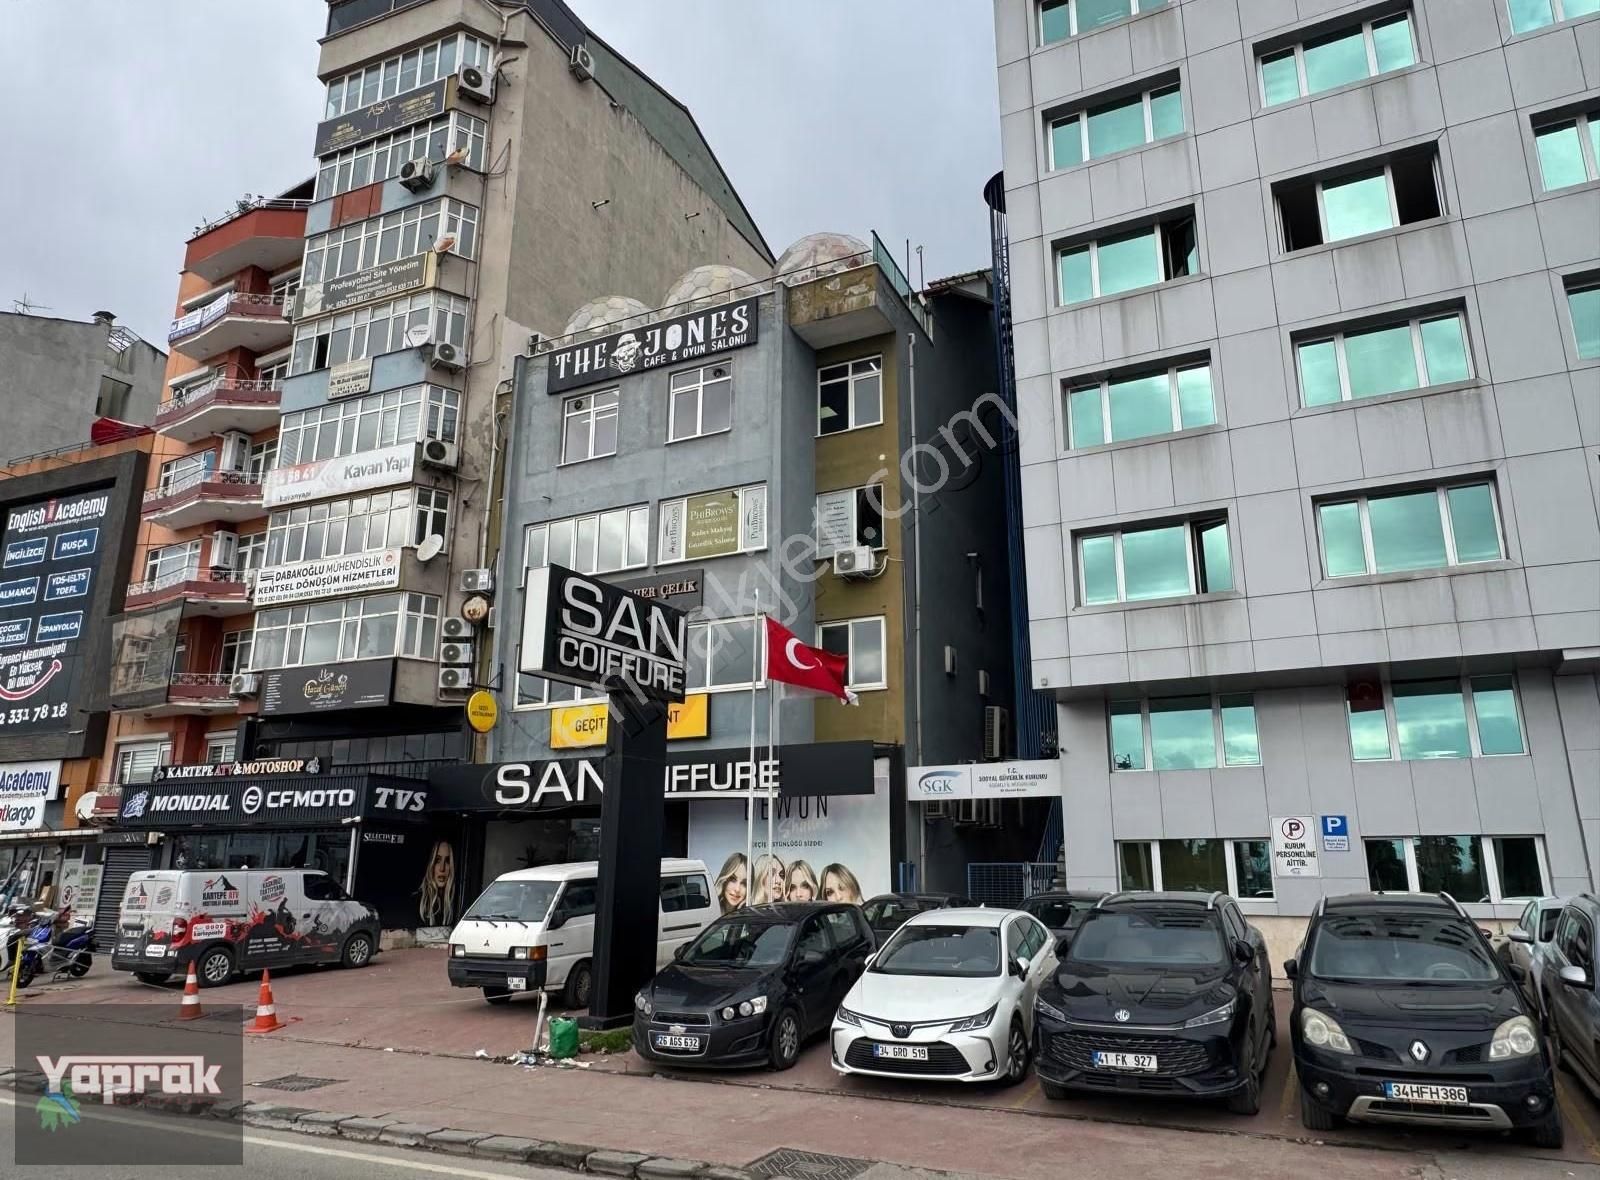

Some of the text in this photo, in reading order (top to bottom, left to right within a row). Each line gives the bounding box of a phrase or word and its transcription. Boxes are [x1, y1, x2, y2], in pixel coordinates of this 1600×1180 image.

[555, 304, 749, 379] THE JONES
[644, 333, 747, 368] CAFE & OYUN SALONU
[343, 461, 383, 480] Kavan
[8, 496, 108, 532] English Academy
[61, 539, 88, 552] RUSÇA
[258, 565, 396, 594] KENTSEL DÖNÜŞÜM HİZMETLERİ
[275, 556, 381, 582] DABAKOĞLU MÜHENDİSLİK
[660, 580, 697, 599] ÇELİK
[561, 576, 685, 662] SAN
[559, 637, 685, 694] COIFFURE
[8, 707, 29, 724] 331
[32, 703, 49, 722] 78
[51, 702, 68, 718] 18
[575, 710, 606, 734] GEÇİT
[0, 770, 51, 796] Academy
[167, 765, 213, 779] KARTEPE
[495, 758, 779, 805] SAN IFFURE
[924, 779, 953, 793] SGK
[151, 787, 428, 812] MONDIAL CFMOTO TVS
[1276, 850, 1317, 858] PERSONELİNE
[1284, 842, 1306, 850] KURUM
[658, 1035, 699, 1048] 26 AGS 632
[878, 1045, 889, 1056] 34
[912, 1048, 927, 1059] 519
[1098, 1052, 1152, 1068] 41 FK 927
